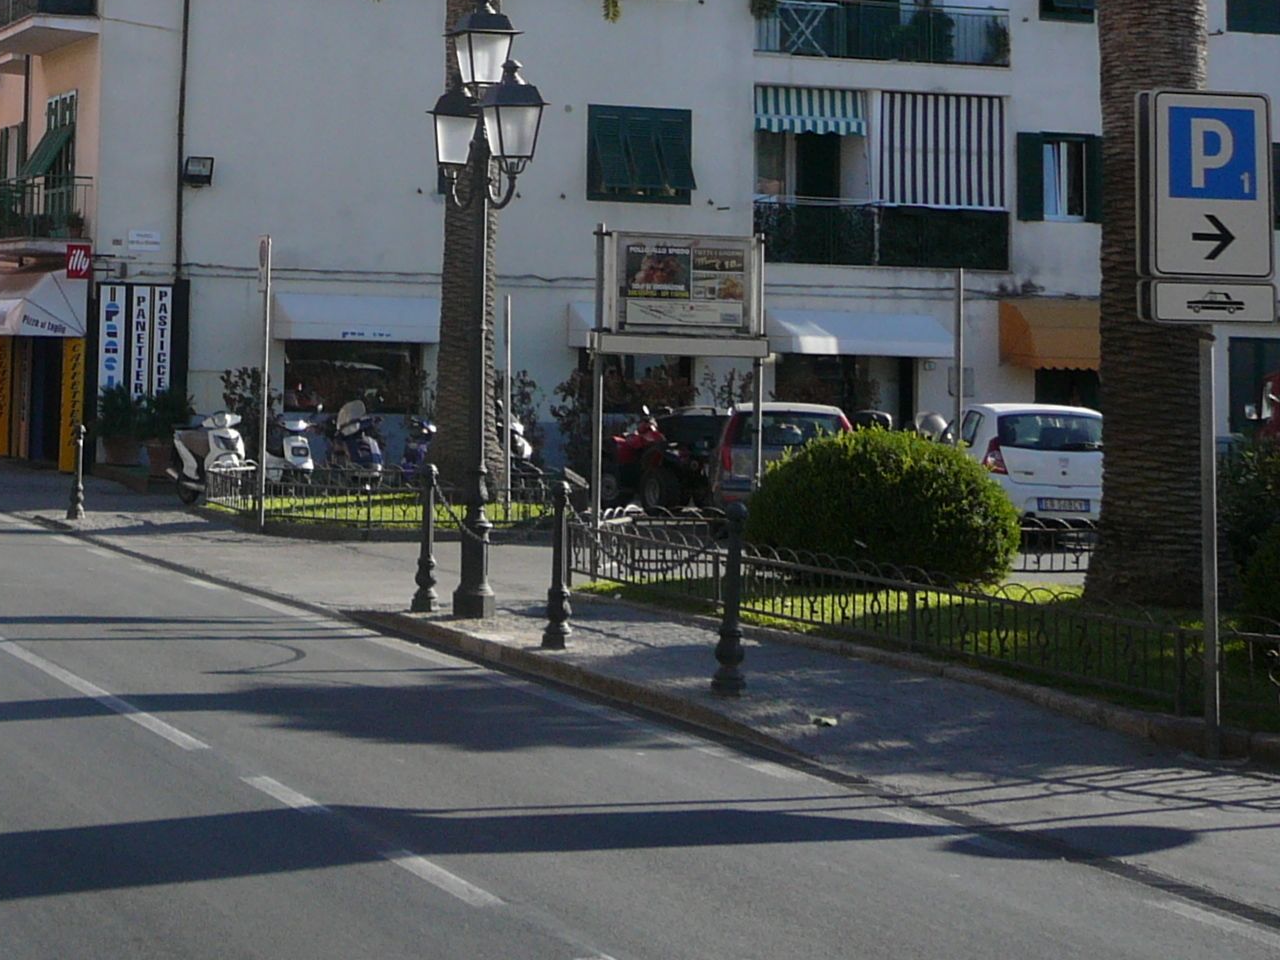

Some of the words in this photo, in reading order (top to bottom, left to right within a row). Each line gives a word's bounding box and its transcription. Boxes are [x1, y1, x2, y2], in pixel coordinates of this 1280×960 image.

[1190, 117, 1234, 188] P
[1240, 171, 1250, 194] 1
[68, 248, 89, 276] illy
[22, 314, 40, 328] Pizza
